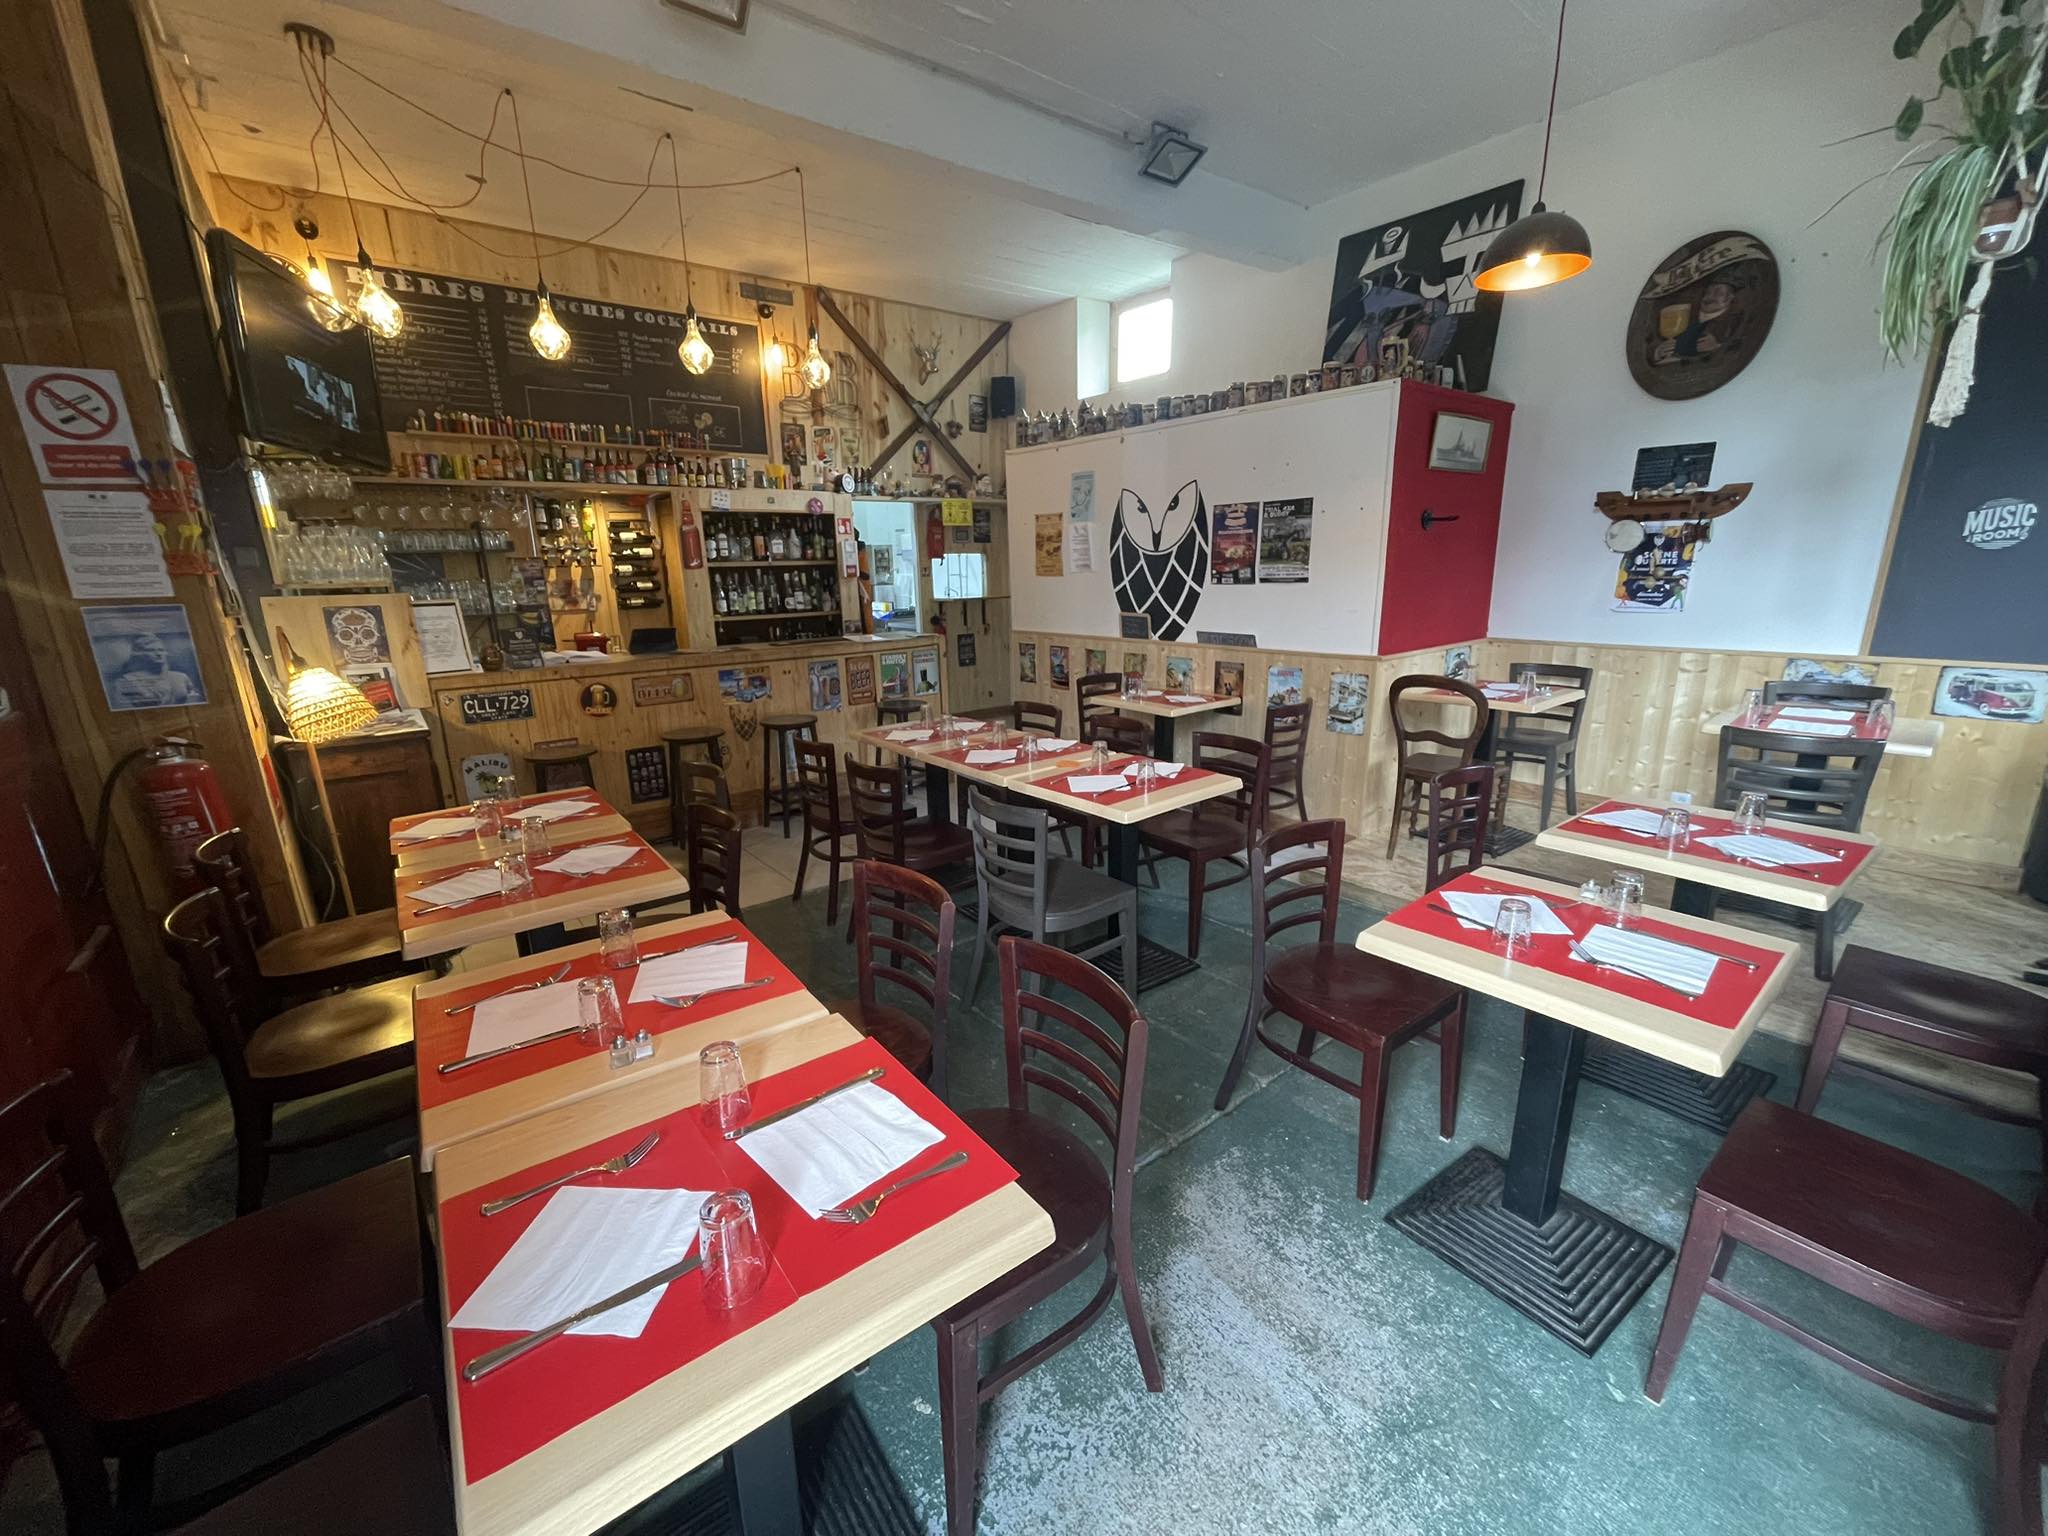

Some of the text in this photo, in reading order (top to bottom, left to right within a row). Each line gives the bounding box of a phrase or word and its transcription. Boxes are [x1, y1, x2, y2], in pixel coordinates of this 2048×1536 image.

[504, 290, 625, 320] PLNCHES
[634, 311, 738, 336] COCKAILS
[1962, 503, 2038, 537] MUSIC
[1971, 527, 2021, 543] ROOM
[1643, 550, 1679, 559] SCNE
[465, 760, 508, 774] MALIBU
